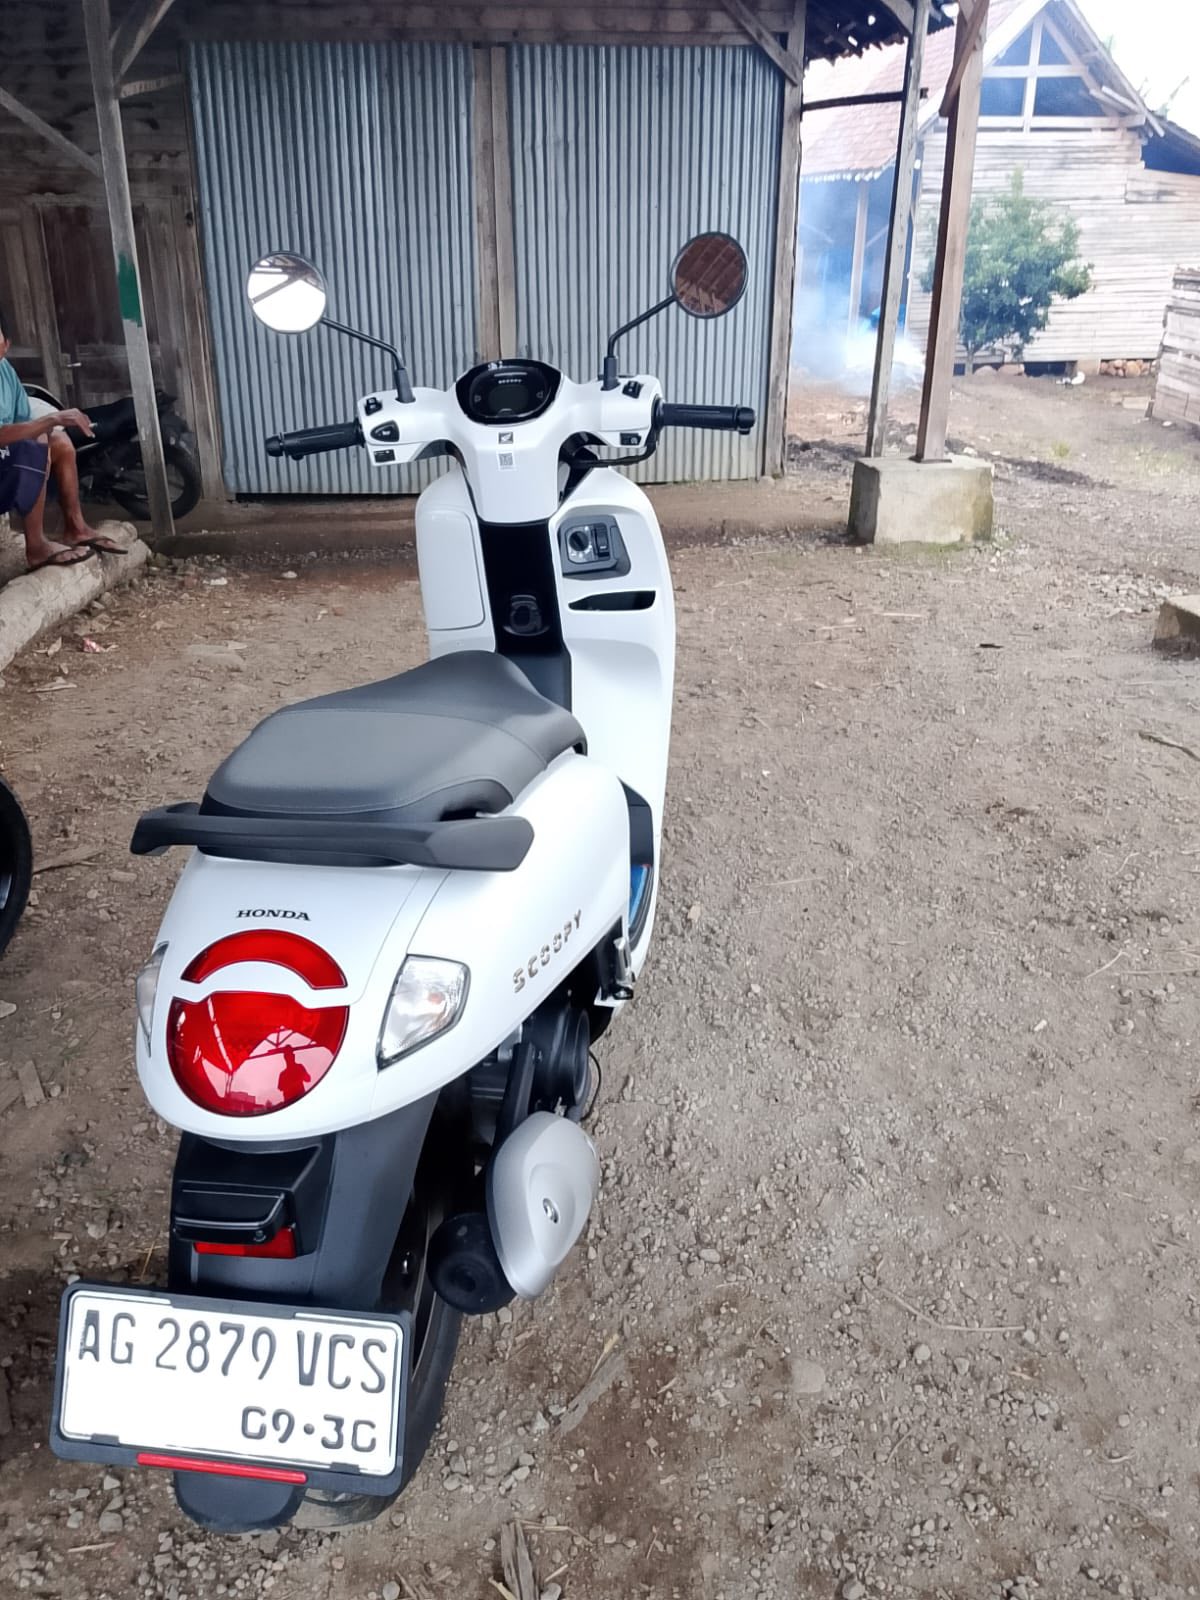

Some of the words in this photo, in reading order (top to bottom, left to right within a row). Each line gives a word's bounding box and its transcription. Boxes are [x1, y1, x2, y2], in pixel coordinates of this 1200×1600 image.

[236, 908, 312, 921] HONDA
[513, 908, 582, 994] SCOOPY
[78, 1309, 136, 1364] AG
[155, 1317, 277, 1380] 2879
[296, 1329, 388, 1394] VCS
